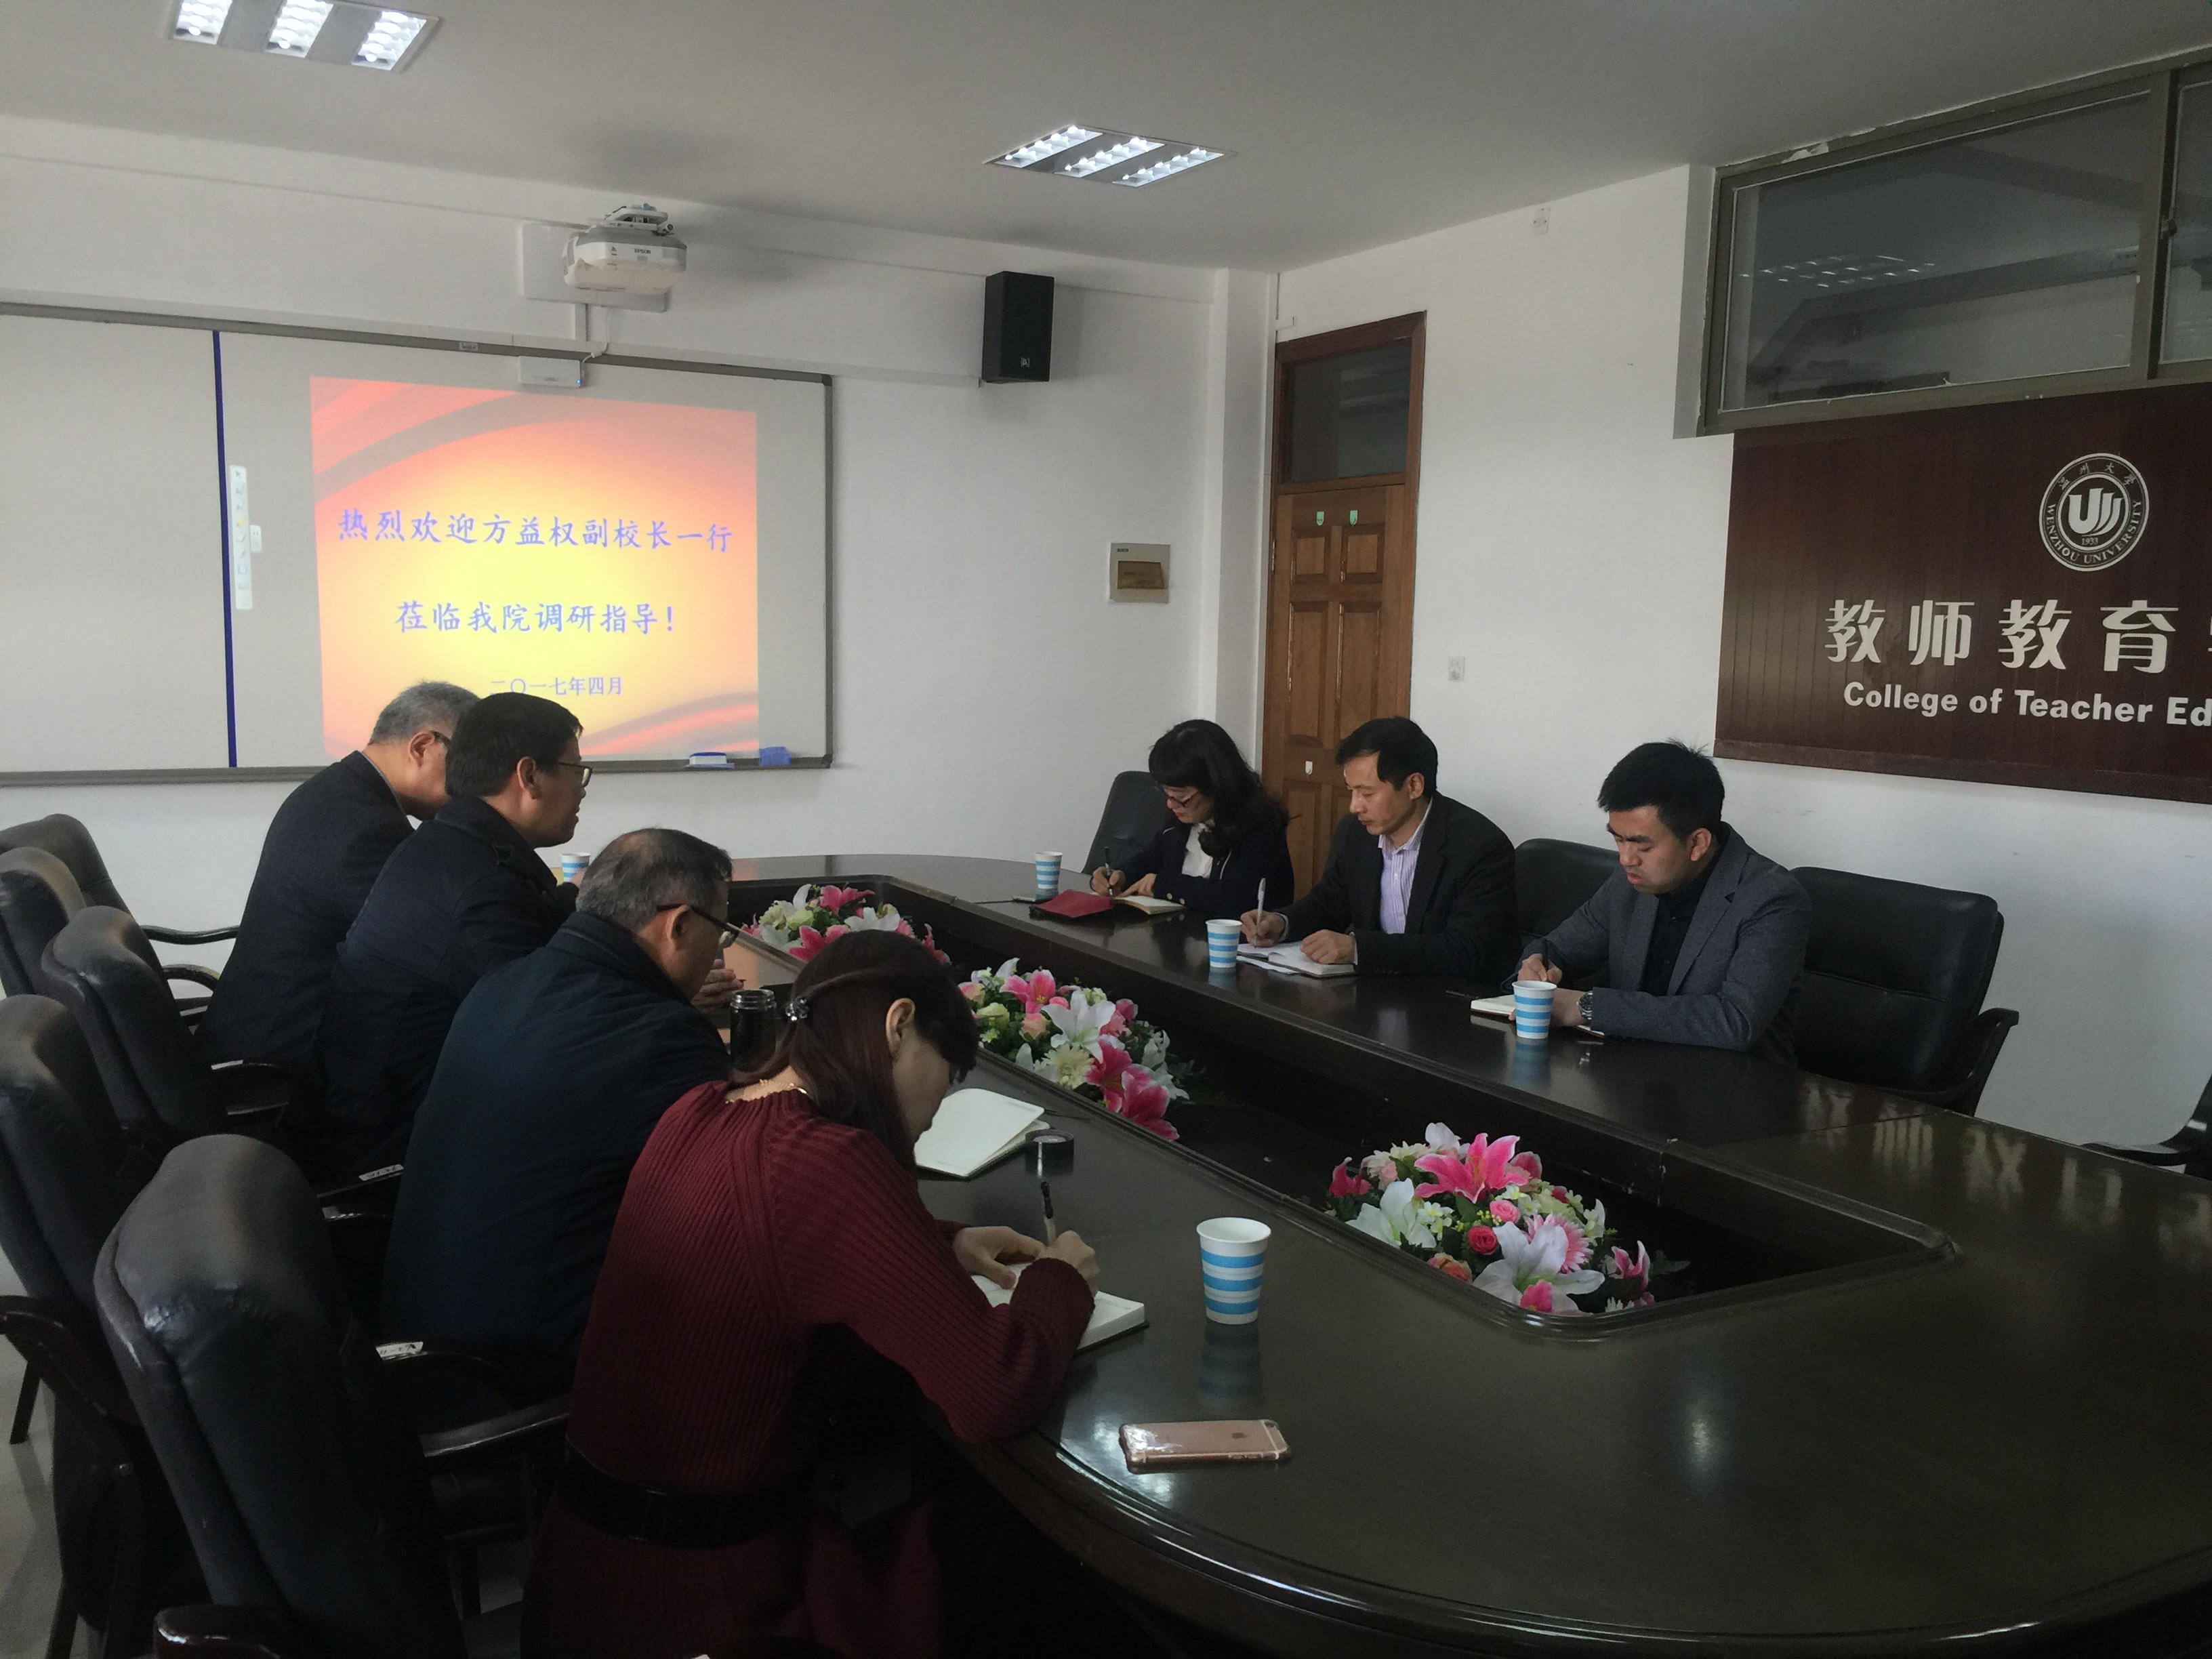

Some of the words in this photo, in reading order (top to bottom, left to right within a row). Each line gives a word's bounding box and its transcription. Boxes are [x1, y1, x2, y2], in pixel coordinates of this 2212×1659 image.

[337, 508, 734, 552] 热烈欢迎方益权副校长一行
[2046, 504, 2079, 562] WENZHOU
[2084, 500, 2142, 564] UNIVERSITY
[2081, 537, 2099, 546] 1933
[1824, 599, 2212, 674] 教师教育
[1843, 682, 1958, 718] College
[1969, 689, 2003, 714] of
[2014, 690, 2154, 723] Teacher
